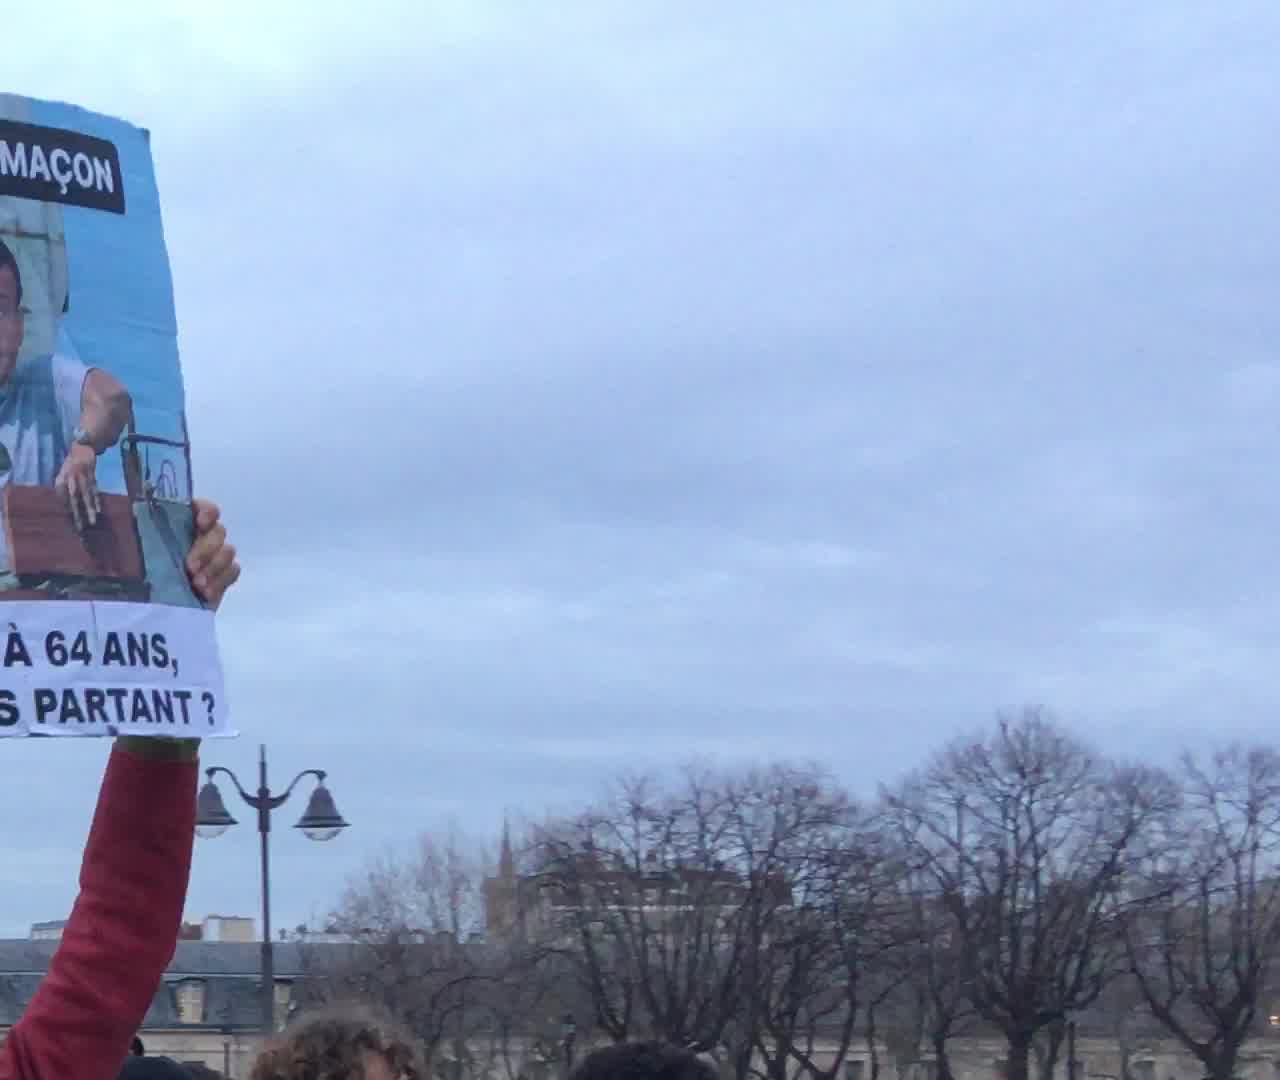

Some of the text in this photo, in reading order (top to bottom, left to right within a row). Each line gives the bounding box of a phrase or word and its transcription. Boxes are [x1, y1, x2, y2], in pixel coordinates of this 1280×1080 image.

[3, 621, 33, 667] À
[45, 630, 92, 667] 64
[102, 631, 178, 678] ANS,
[34, 688, 192, 724] PARTANT
[201, 691, 215, 726] ?
